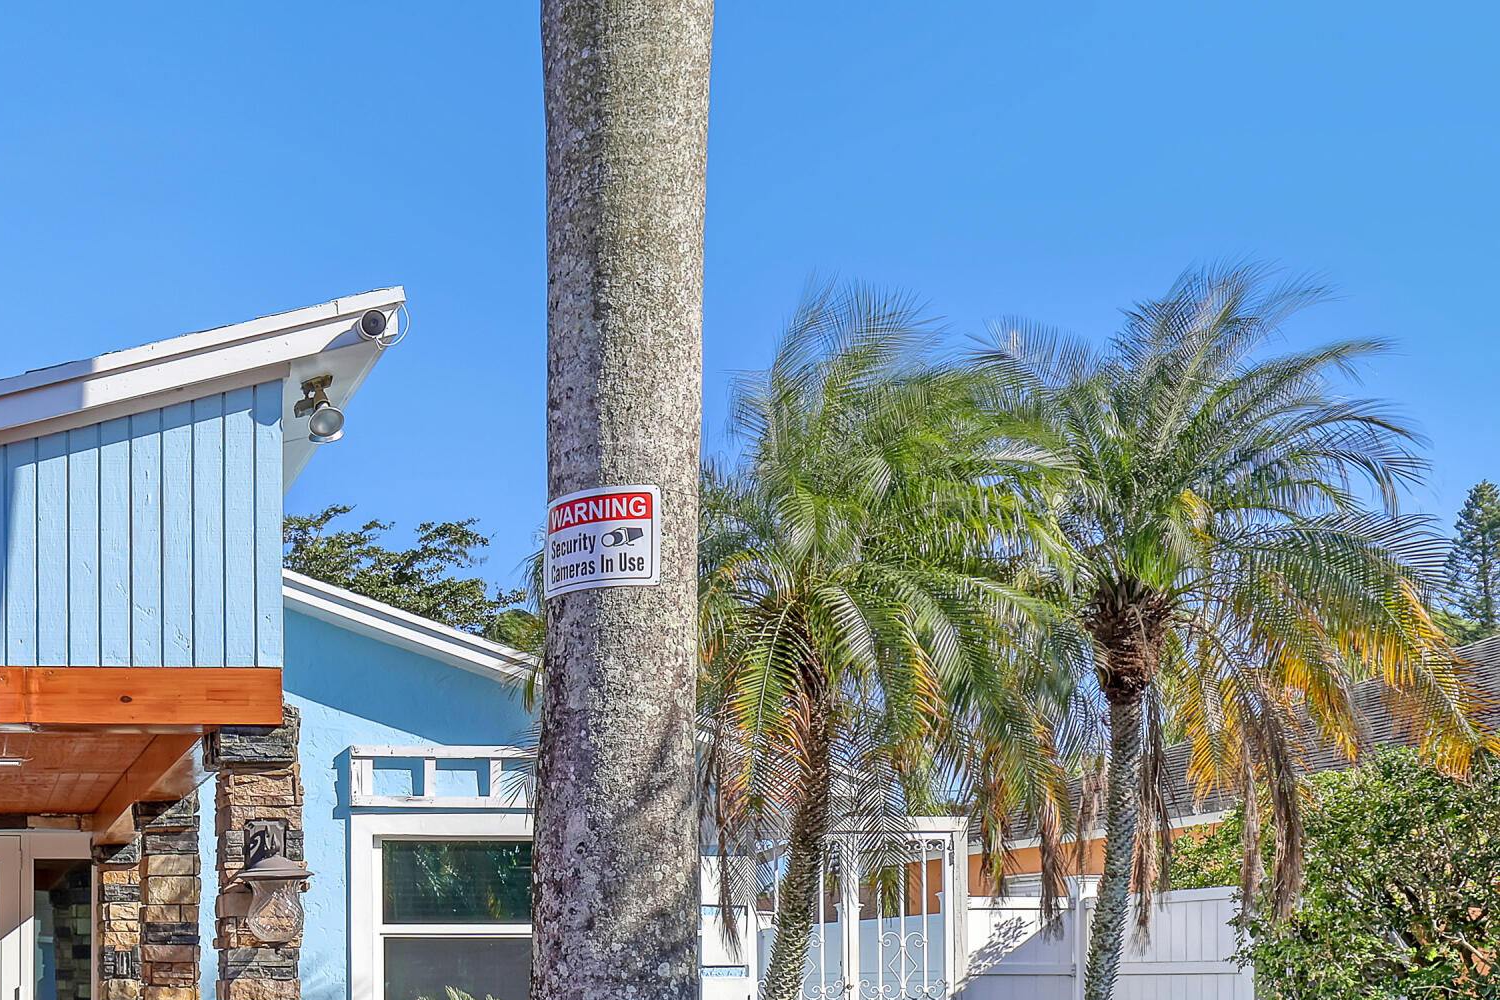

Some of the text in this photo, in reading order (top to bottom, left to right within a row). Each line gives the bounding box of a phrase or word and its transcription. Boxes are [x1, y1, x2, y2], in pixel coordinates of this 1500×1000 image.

[551, 496, 647, 530] WARNING
[551, 532, 597, 560] Security
[551, 552, 645, 585] Cameras In Use
